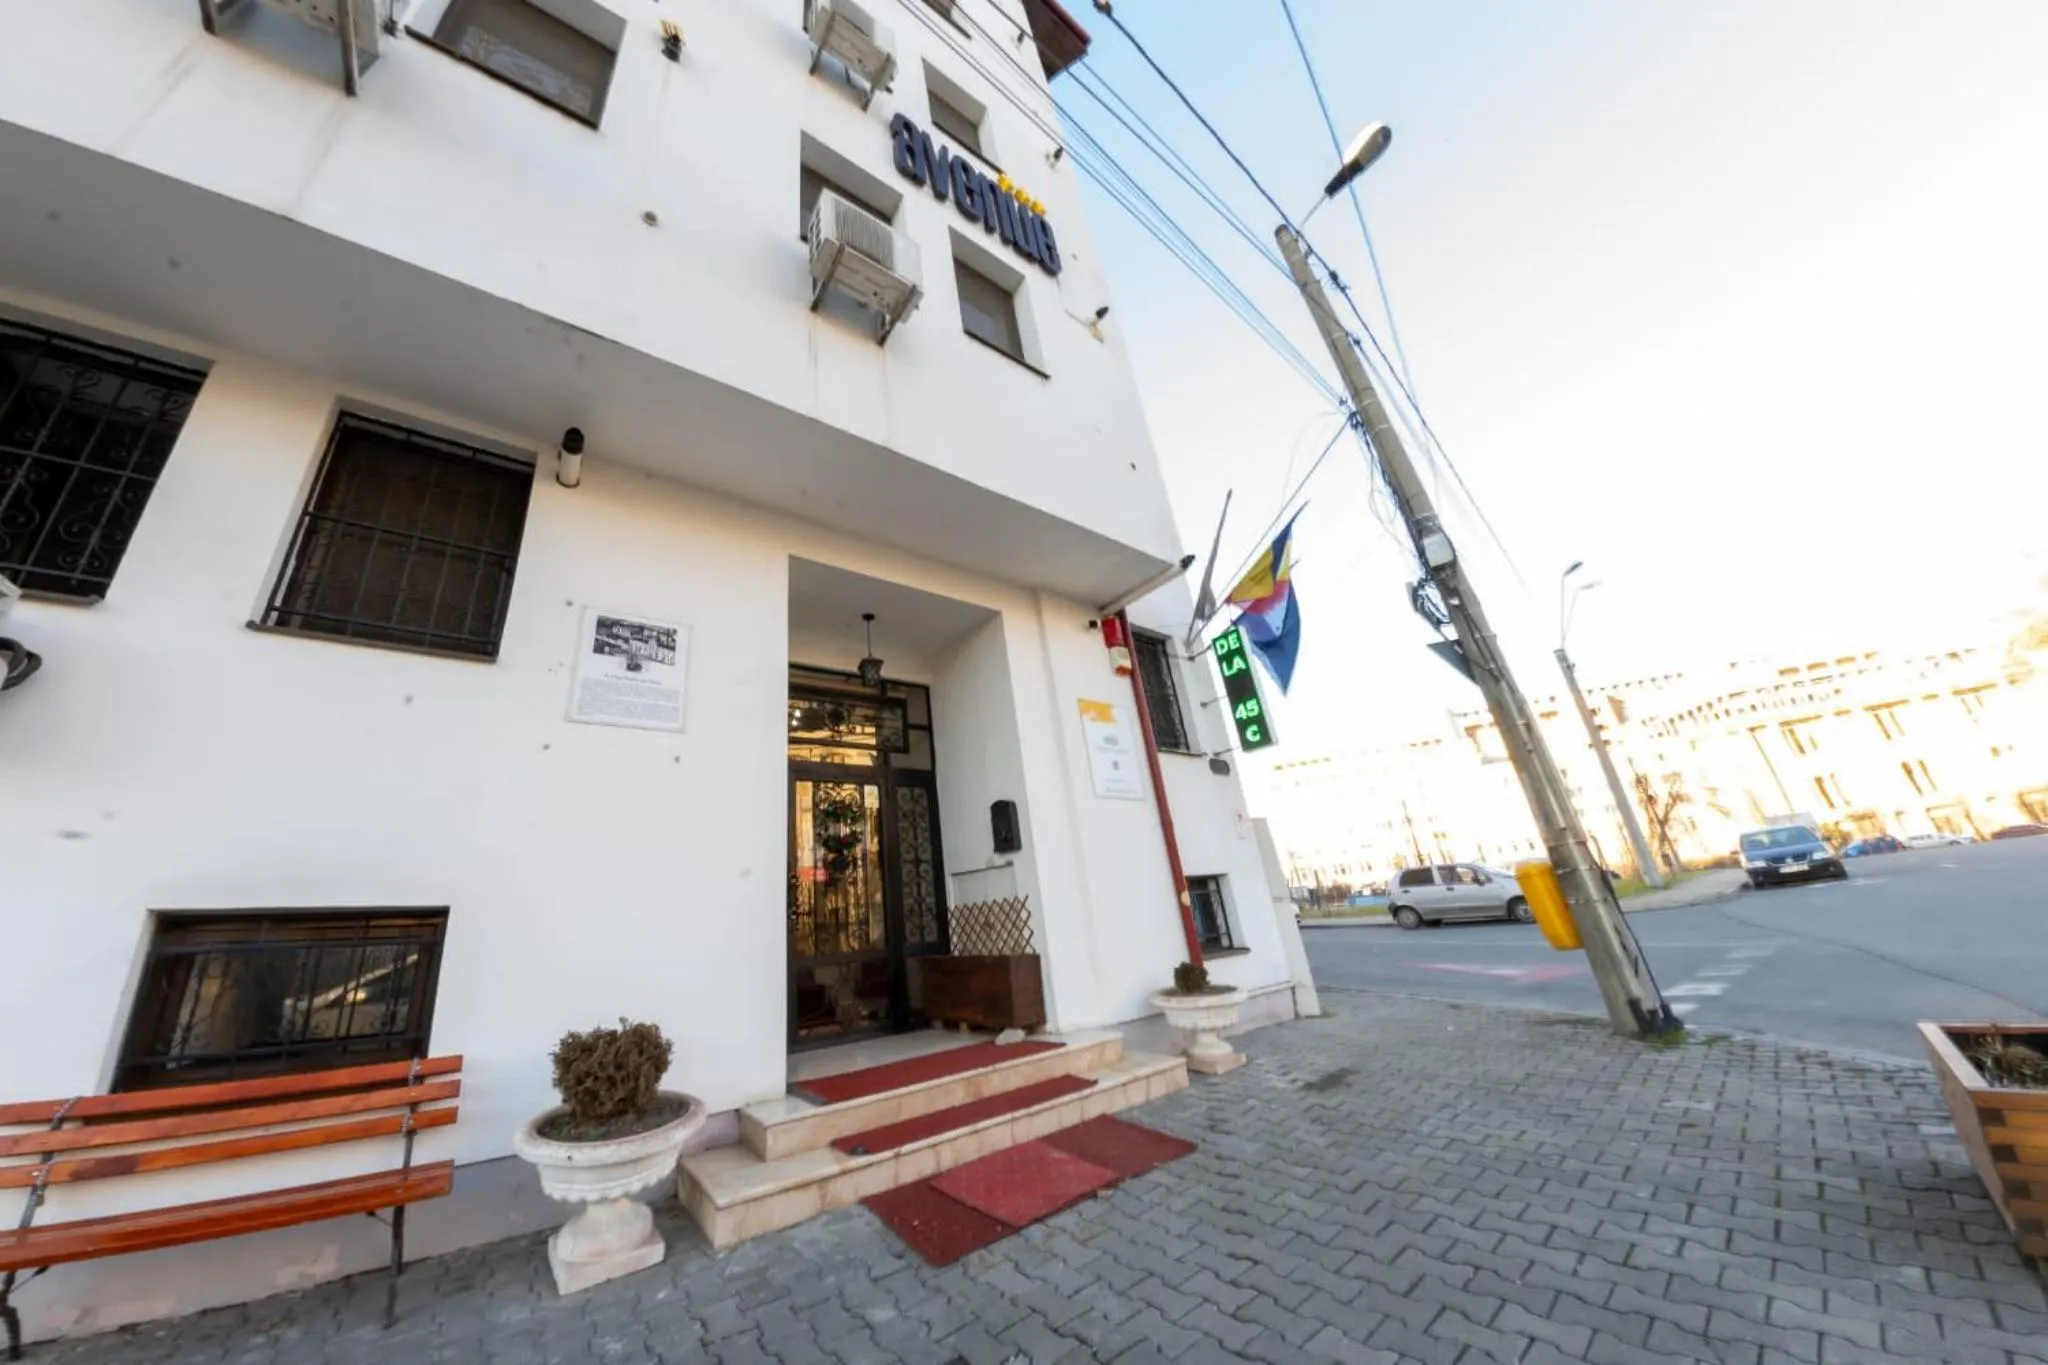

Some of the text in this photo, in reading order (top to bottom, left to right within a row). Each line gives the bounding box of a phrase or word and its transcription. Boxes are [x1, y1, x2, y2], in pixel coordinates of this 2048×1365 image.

[889, 113, 1062, 275] avenue
[1215, 631, 1240, 655] DE
[1222, 655, 1246, 676] LA
[1235, 698, 1259, 720] 45
